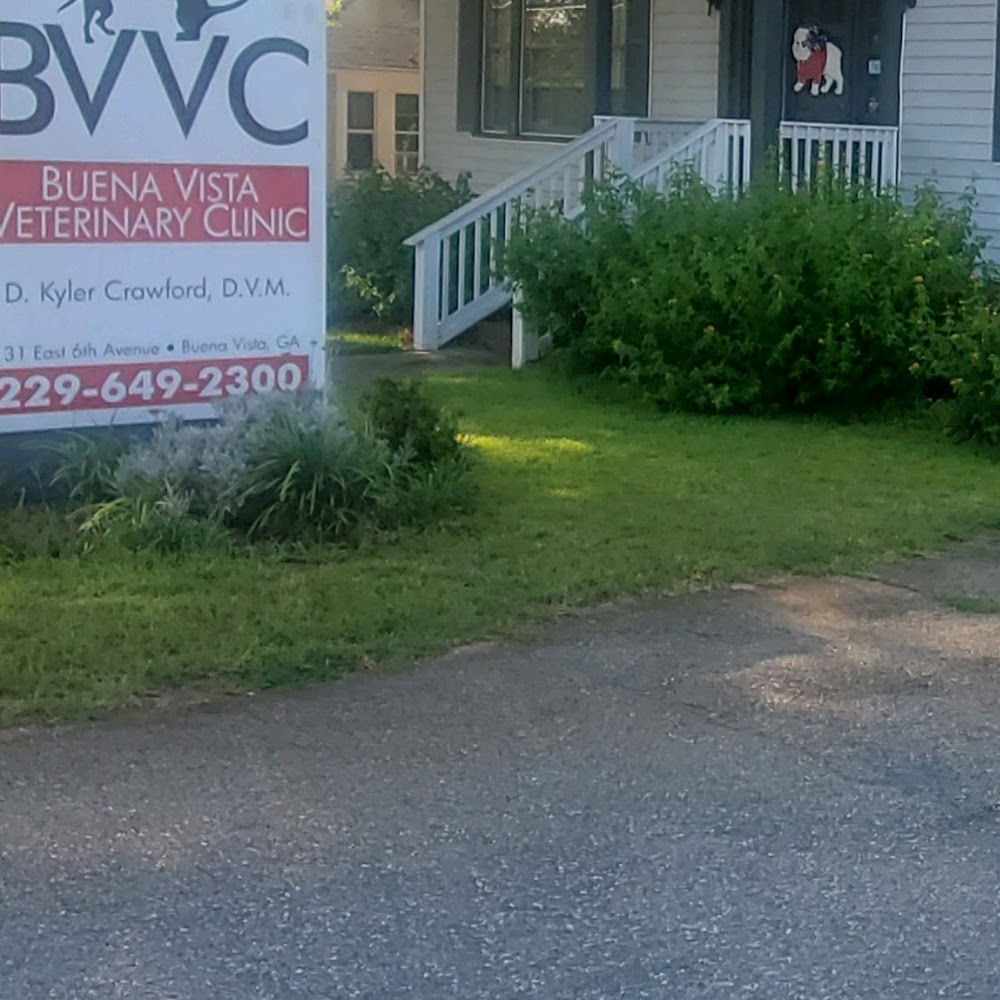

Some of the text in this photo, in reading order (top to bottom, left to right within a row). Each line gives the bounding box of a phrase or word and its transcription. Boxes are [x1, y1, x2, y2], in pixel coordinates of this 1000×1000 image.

[0, 21, 309, 146] BVVC
[42, 165, 259, 203] BUENA VISTA
[203, 203, 307, 238] CLINIC
[5, 277, 290, 308] D. Kyler Crawford, D.V.M.
[33, 344, 66, 361] East
[71, 343, 97, 359] 6th
[103, 342, 160, 357] Avenue
[182, 339, 227, 354] Buena
[232, 338, 270, 351] Vista,
[276, 335, 300, 349] GA
[0, 363, 301, 408] 229-649-2300
